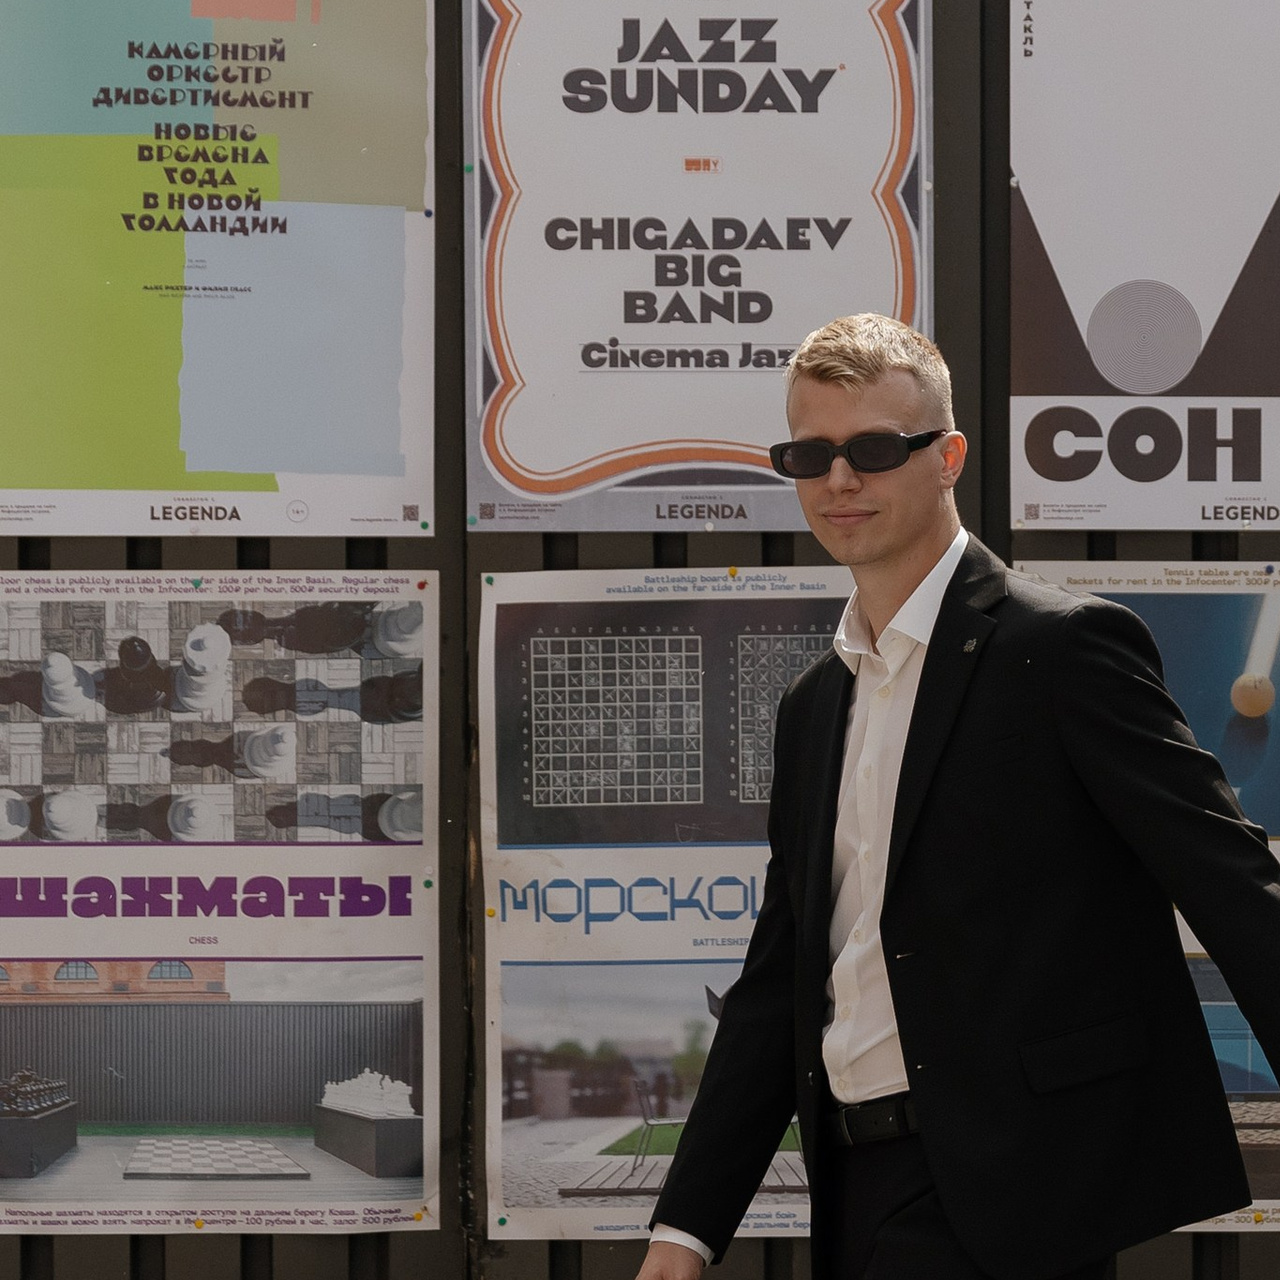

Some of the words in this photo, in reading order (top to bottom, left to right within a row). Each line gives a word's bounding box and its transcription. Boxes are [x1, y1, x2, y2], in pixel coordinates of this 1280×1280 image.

[127, 38, 286, 62] КАМЕРНЫЙ
[617, 17, 779, 63] JAZZ
[147, 64, 272, 84] ОРКЕСТР
[92, 86, 313, 109] ДИВЕРТИСМЕНТ
[154, 122, 257, 142] НОВЫЕ
[137, 144, 270, 164] ВРЕМЕНА
[163, 166, 237, 188] ГОДА
[143, 192, 159, 210] В
[167, 187, 262, 211] НОВОЙ
[120, 213, 287, 236] ГОЛЛАНДИИ
[544, 217, 853, 251] CHIGADAEV
[654, 253, 742, 287] BIG
[623, 290, 773, 324] BAND
[581, 336, 730, 369] Cinema
[739, 341, 797, 369] Jaz
[1024, 405, 1262, 482] СОН
[150, 505, 241, 521] LEGENDA
[655, 504, 748, 520] LEGENDA
[24, 576, 51, 585] chess
[56, 576, 66, 585] is
[69, 576, 110, 587] publicly
[115, 576, 161, 585] available
[200, 576, 215, 585] far
[218, 576, 238, 585] side
[242, 576, 253, 585] of
[257, 576, 273, 585] the
[276, 576, 302, 585] Inner
[305, 576, 335, 585] Basin.
[342, 576, 380, 587] Regular
[383, 576, 411, 585] chess
[606, 584, 653, 594] available
[673, 584, 688, 592] the
[692, 584, 708, 592] far
[711, 583, 733, 592] side
[736, 583, 747, 591] of
[750, 583, 767, 591] the
[770, 582, 796, 591] Inner
[799, 582, 826, 590] Basin
[645, 575, 697, 585] Battleship
[700, 574, 728, 583] board
[745, 573, 787, 584] publicly
[189, 936, 219, 945] CHESS
[692, 937, 750, 947] BATTLESHIP
